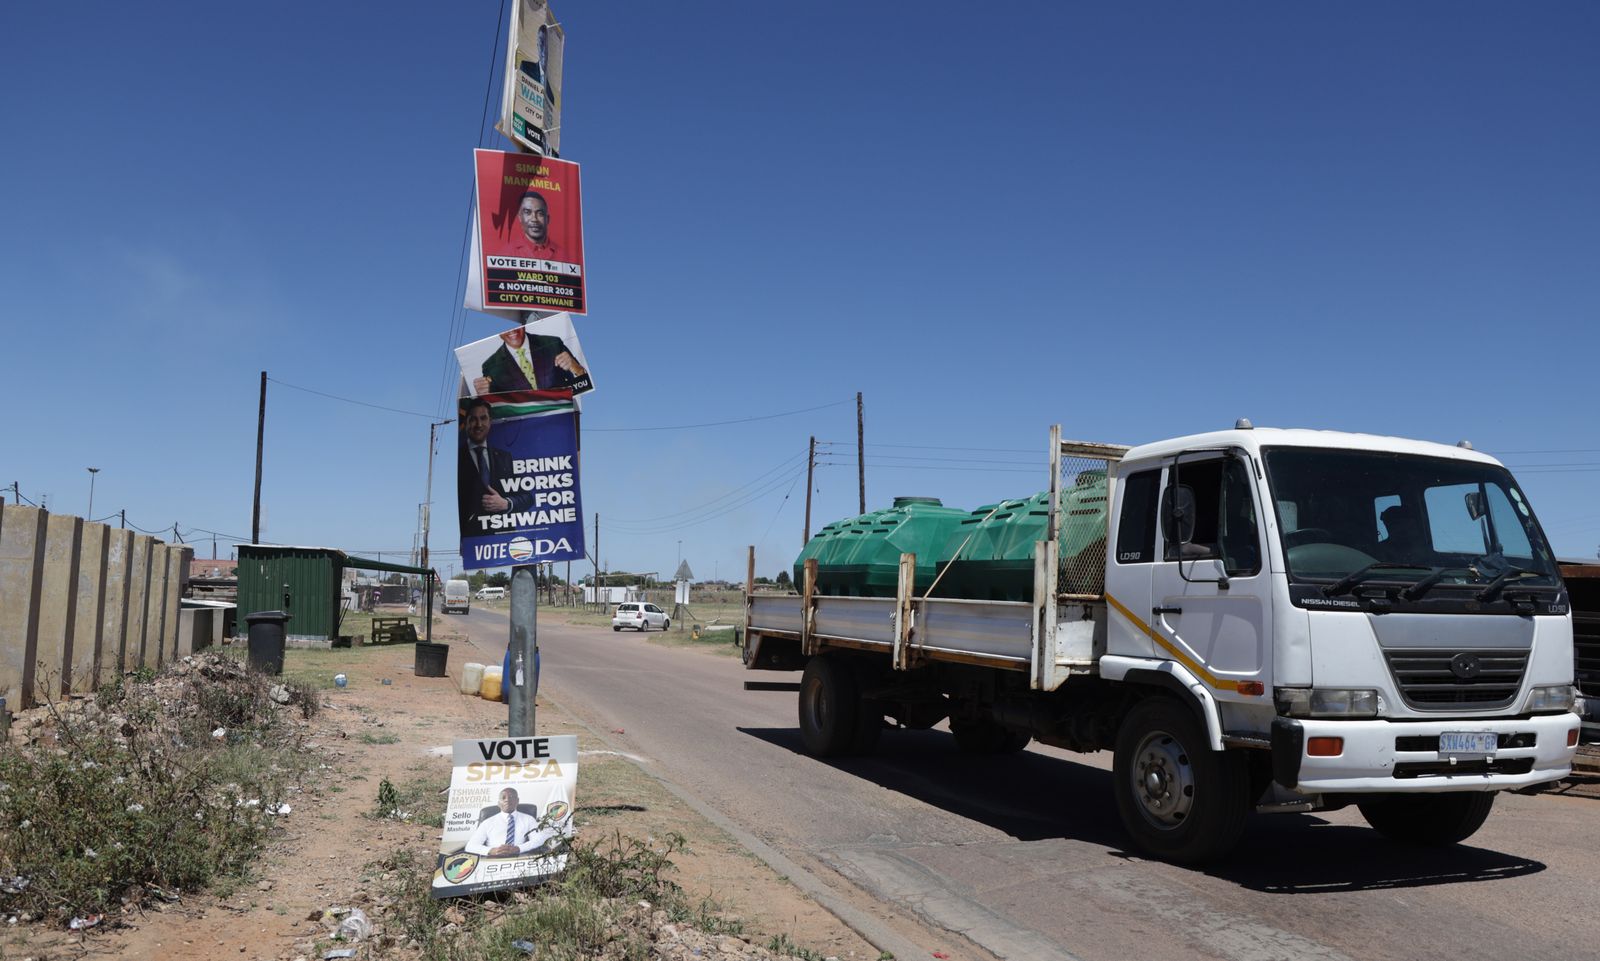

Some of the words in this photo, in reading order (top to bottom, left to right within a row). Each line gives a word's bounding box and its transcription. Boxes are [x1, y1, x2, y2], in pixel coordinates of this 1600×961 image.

[521, 75, 540, 93] DANIEL
[525, 106, 535, 116] CITY
[536, 112, 543, 120] OF
[527, 126, 541, 141] VOTE
[515, 163, 550, 176] SIMON
[504, 175, 561, 192] MANAMELA
[490, 257, 517, 267] VOTE
[519, 260, 537, 269] EFF
[517, 271, 543, 281] WARD
[545, 273, 559, 283] 103
[506, 283, 554, 294] NOVEMBER
[555, 286, 574, 296] 2026
[499, 294, 520, 303] CITY
[522, 295, 534, 303] OF
[536, 296, 574, 307] TSHWANE
[573, 380, 588, 390] YOU
[512, 455, 573, 475] BRINK
[500, 473, 574, 493] WORKS
[535, 491, 575, 508] FOR
[478, 507, 577, 530] TSHWANE
[475, 542, 508, 561] VOTE
[535, 537, 573, 556] DA
[1301, 598, 1332, 606] NISSAN
[1332, 600, 1361, 608] DIESEL
[478, 738, 550, 761] VOTE
[1484, 735, 1496, 750] GP
[465, 758, 564, 783] SPPSA
[452, 788, 491, 796] TSHWANE
[451, 795, 492, 804] MAYORAL
[452, 812, 472, 820] Sello
[486, 860, 553, 874] SPPSA
